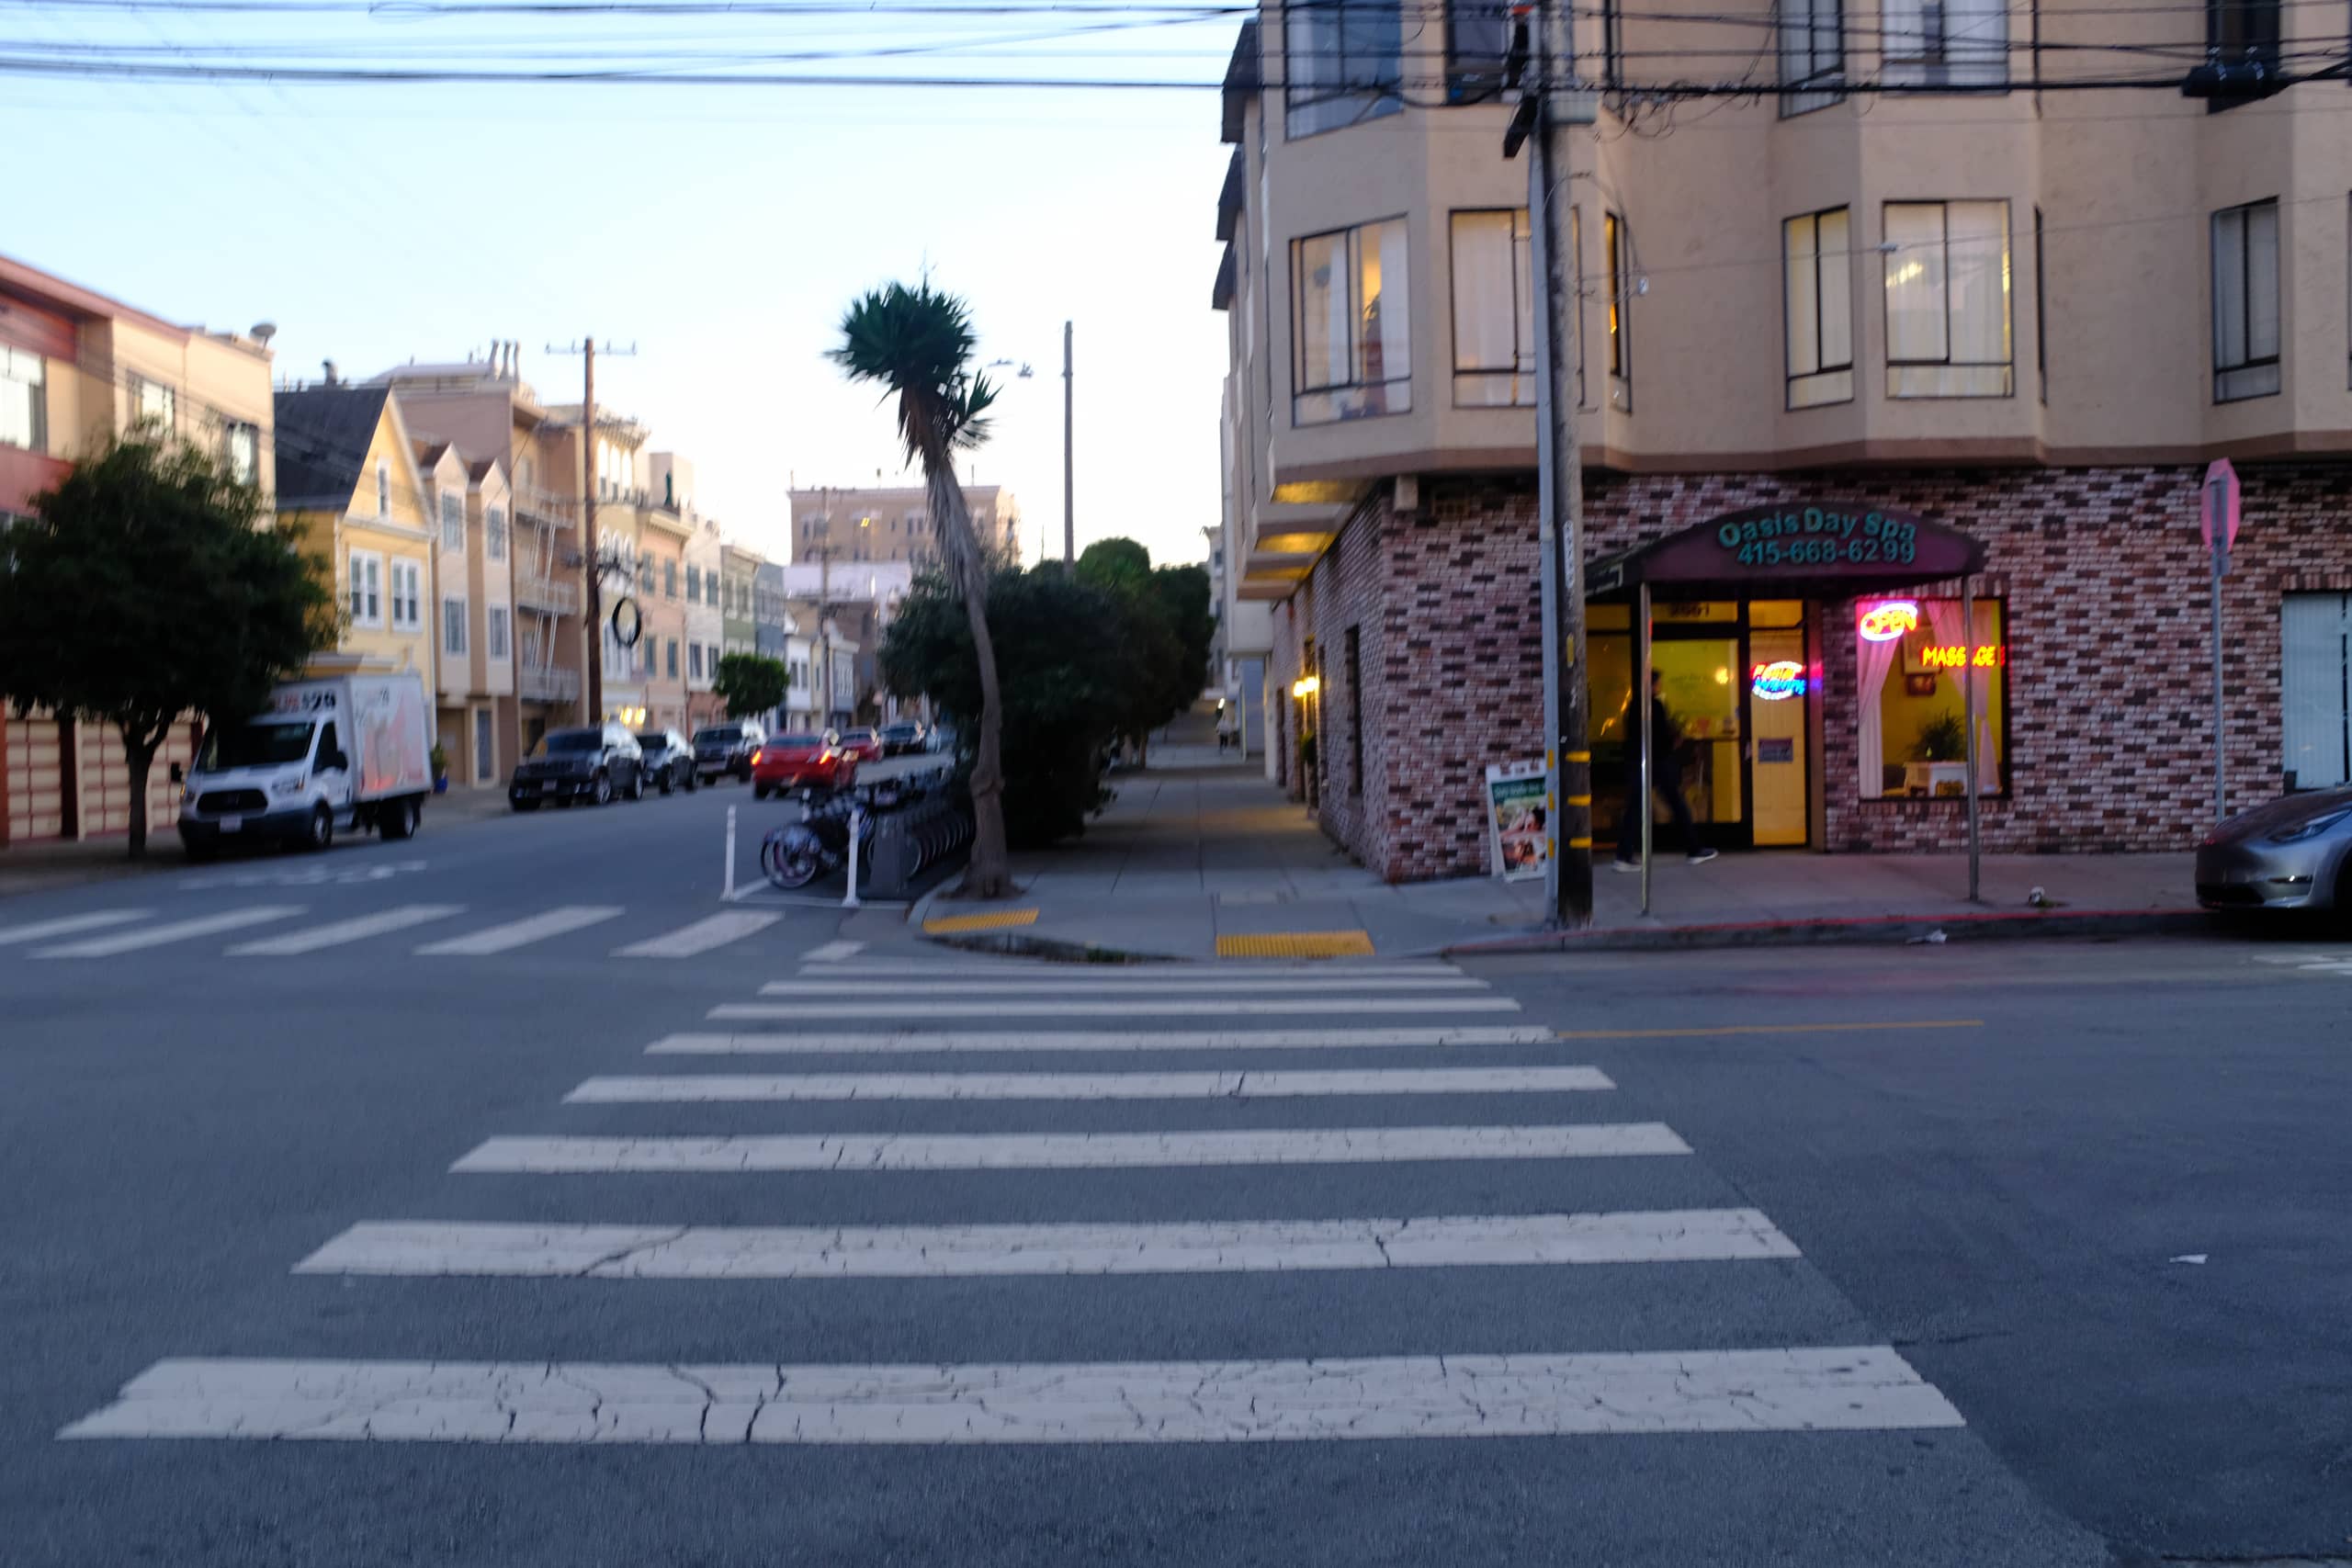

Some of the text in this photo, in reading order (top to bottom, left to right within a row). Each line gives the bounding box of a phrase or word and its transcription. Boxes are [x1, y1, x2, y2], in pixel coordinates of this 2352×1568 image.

[1719, 506, 1917, 547] Oasis Day Spa
[1736, 538, 1917, 565] 415-668-6299
[1861, 609, 1917, 635] OPEN
